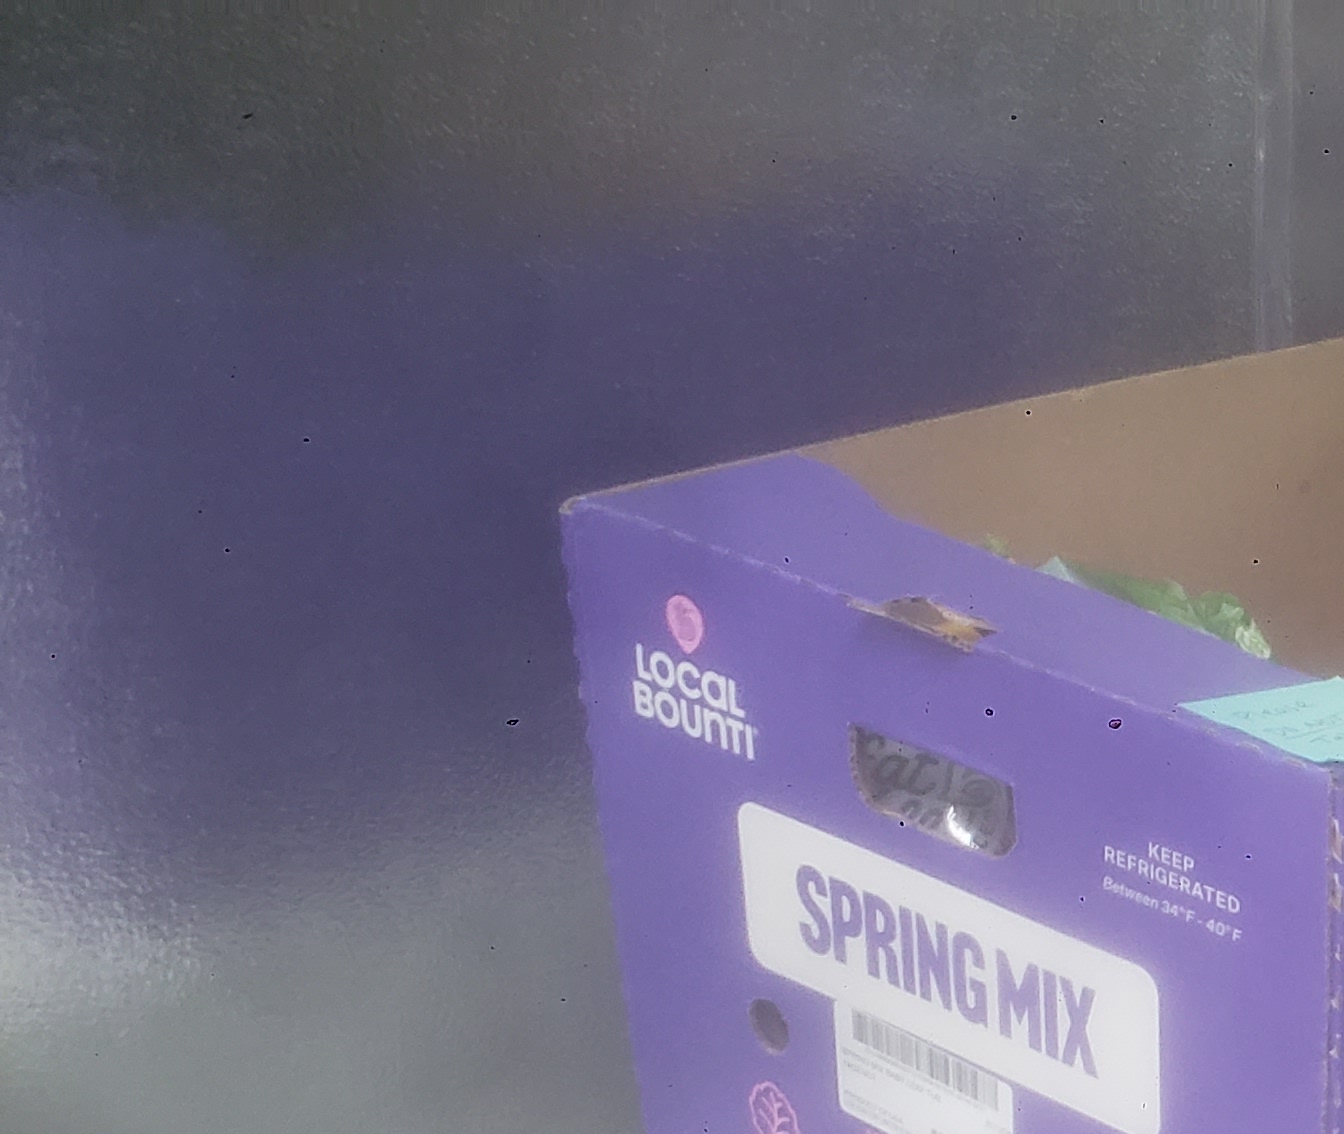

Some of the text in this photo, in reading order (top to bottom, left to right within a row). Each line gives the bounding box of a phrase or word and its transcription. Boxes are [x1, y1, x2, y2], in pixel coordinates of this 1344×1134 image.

[1103, 845, 1241, 913] REFRIGERATED
[1149, 841, 1194, 872] KEEP
[1103, 876, 1159, 910] Between
[796, 866, 987, 1028] SPRING
[997, 949, 1099, 1080] MIX
